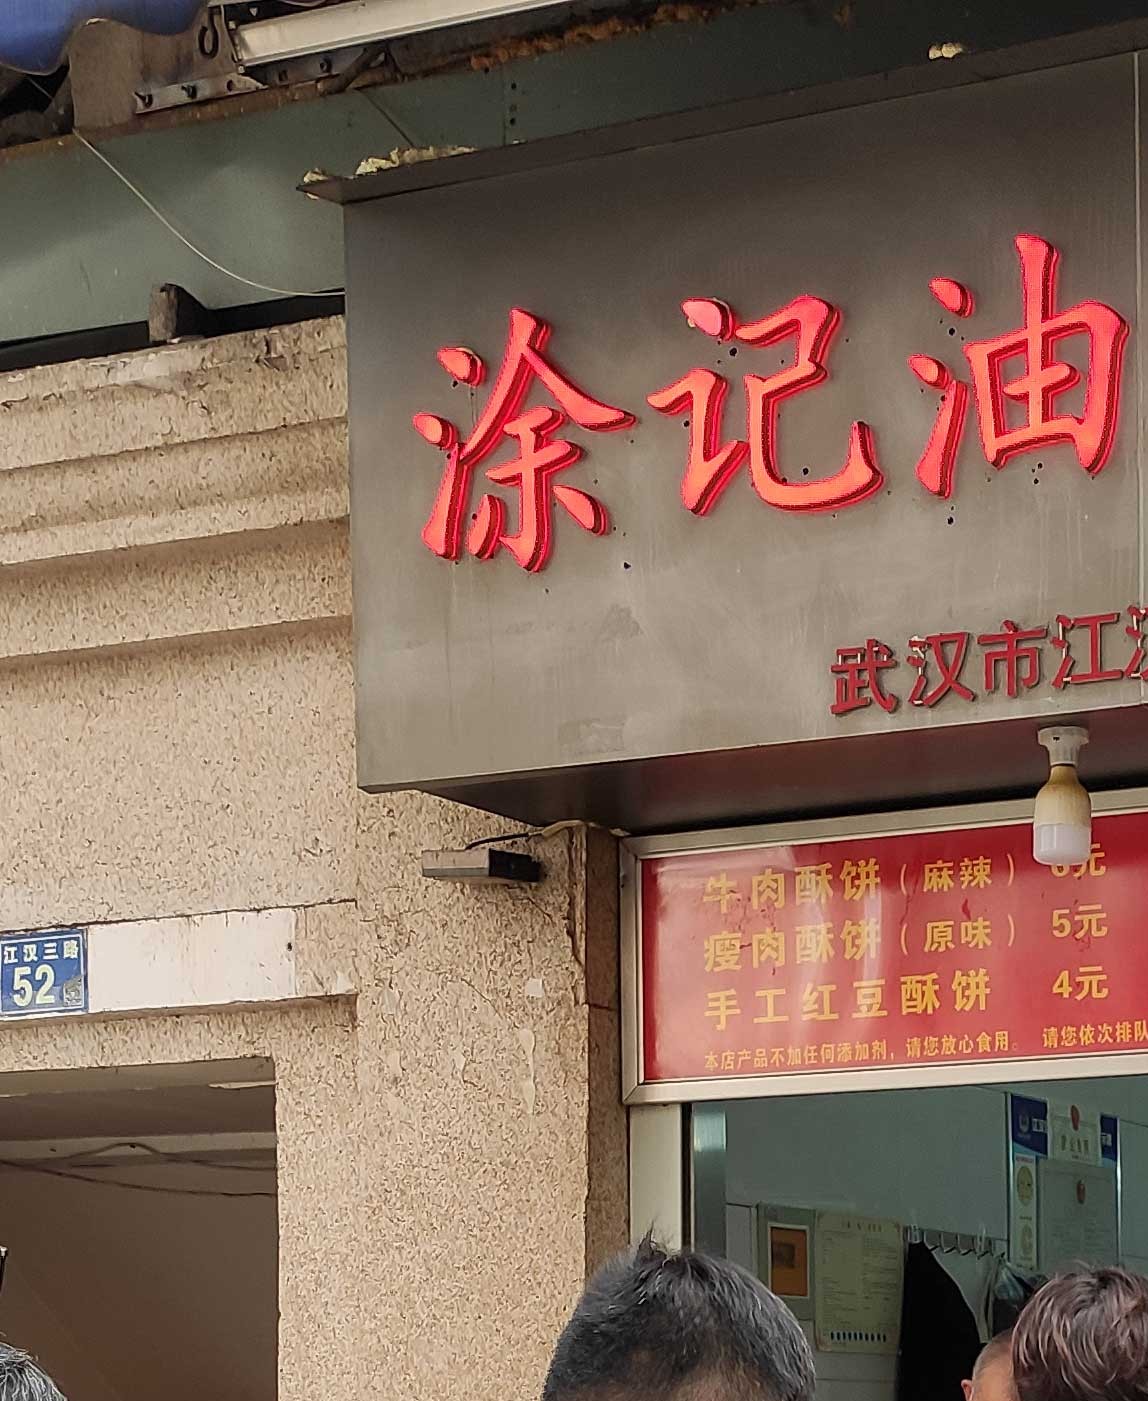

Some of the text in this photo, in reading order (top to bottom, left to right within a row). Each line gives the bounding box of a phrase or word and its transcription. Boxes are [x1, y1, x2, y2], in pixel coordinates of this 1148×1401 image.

[703, 852, 1016, 914] 牛肉酥饼（麻辣）
[4, 940, 78, 964] 江汉三路
[703, 904, 1108, 974] 瘦肉酥饼（原味） 5元
[13, 964, 55, 1007] 52
[703, 965, 1109, 1032] 手工红豆酥饼 4元
